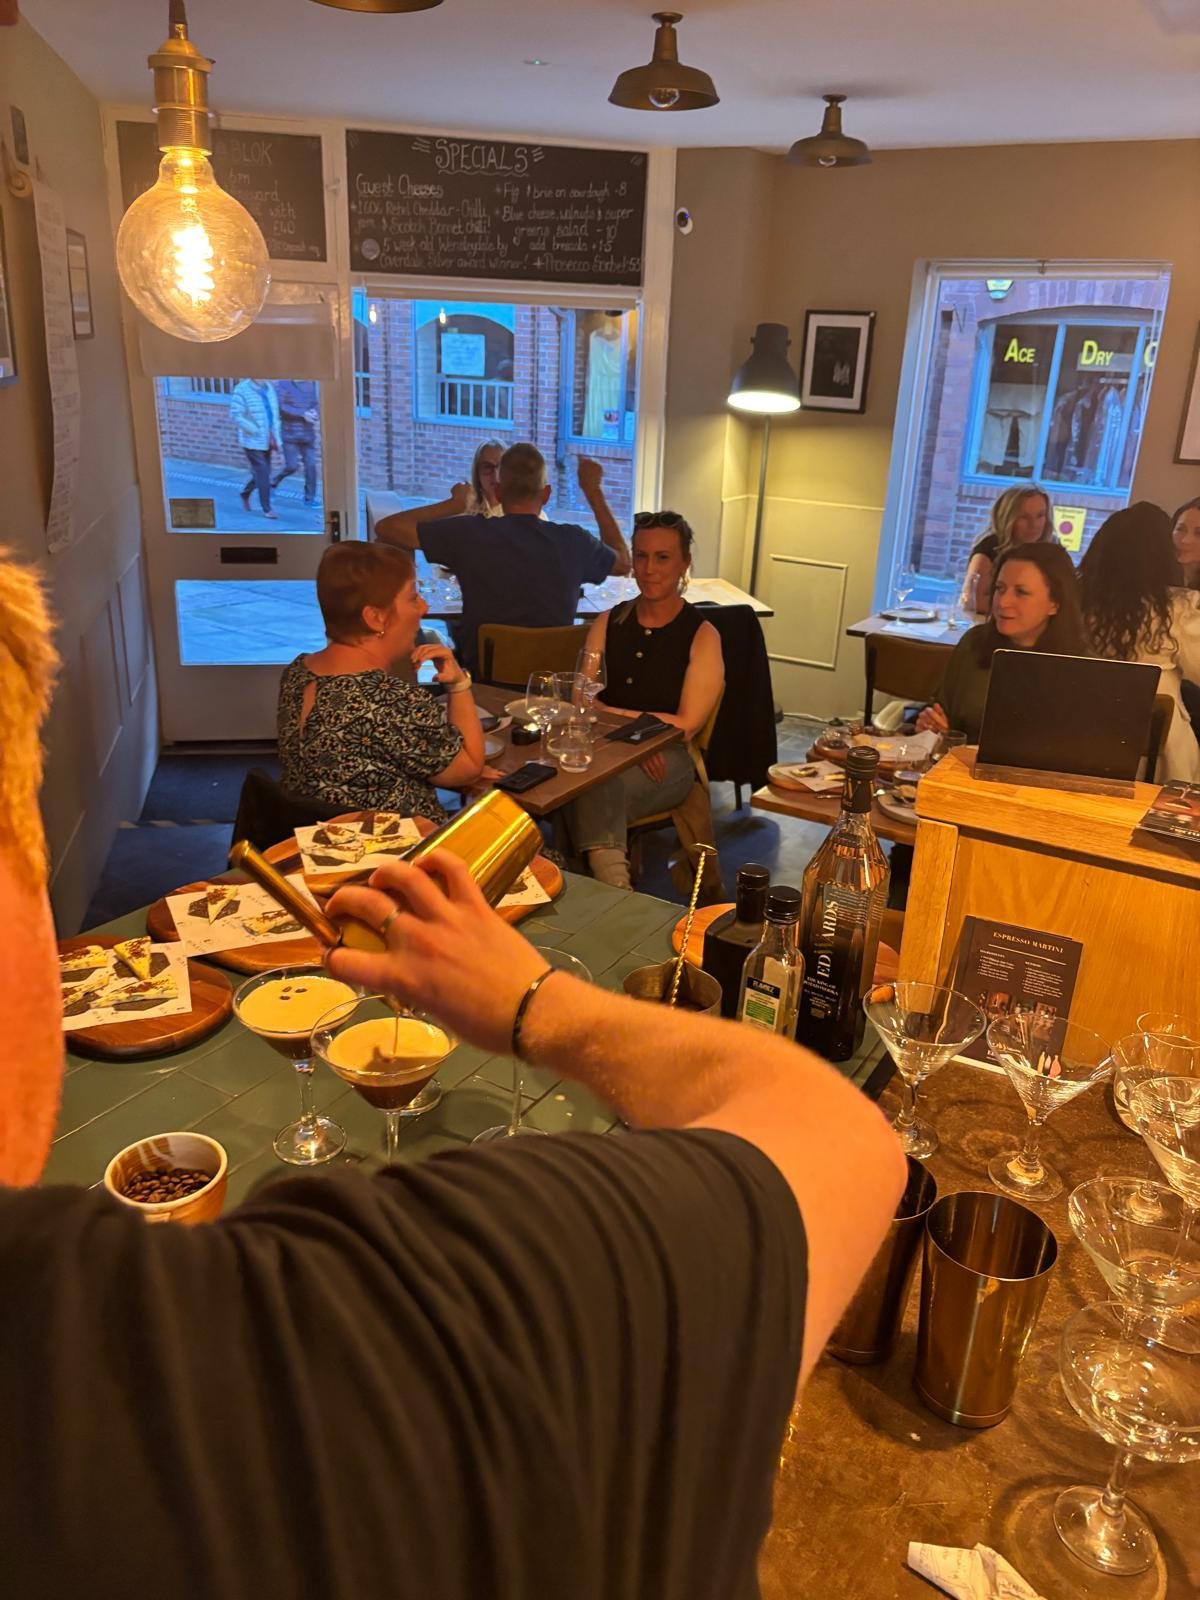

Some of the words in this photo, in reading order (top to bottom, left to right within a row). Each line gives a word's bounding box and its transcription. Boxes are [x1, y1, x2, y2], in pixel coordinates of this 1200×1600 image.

[434, 138, 529, 173] SPECIALS
[355, 172, 393, 197] Guest
[503, 182, 520, 204] Fig
[1080, 339, 1114, 365] DRY
[993, 931, 1030, 946] ESPRESSO
[1032, 940, 1064, 954] MARTINI
